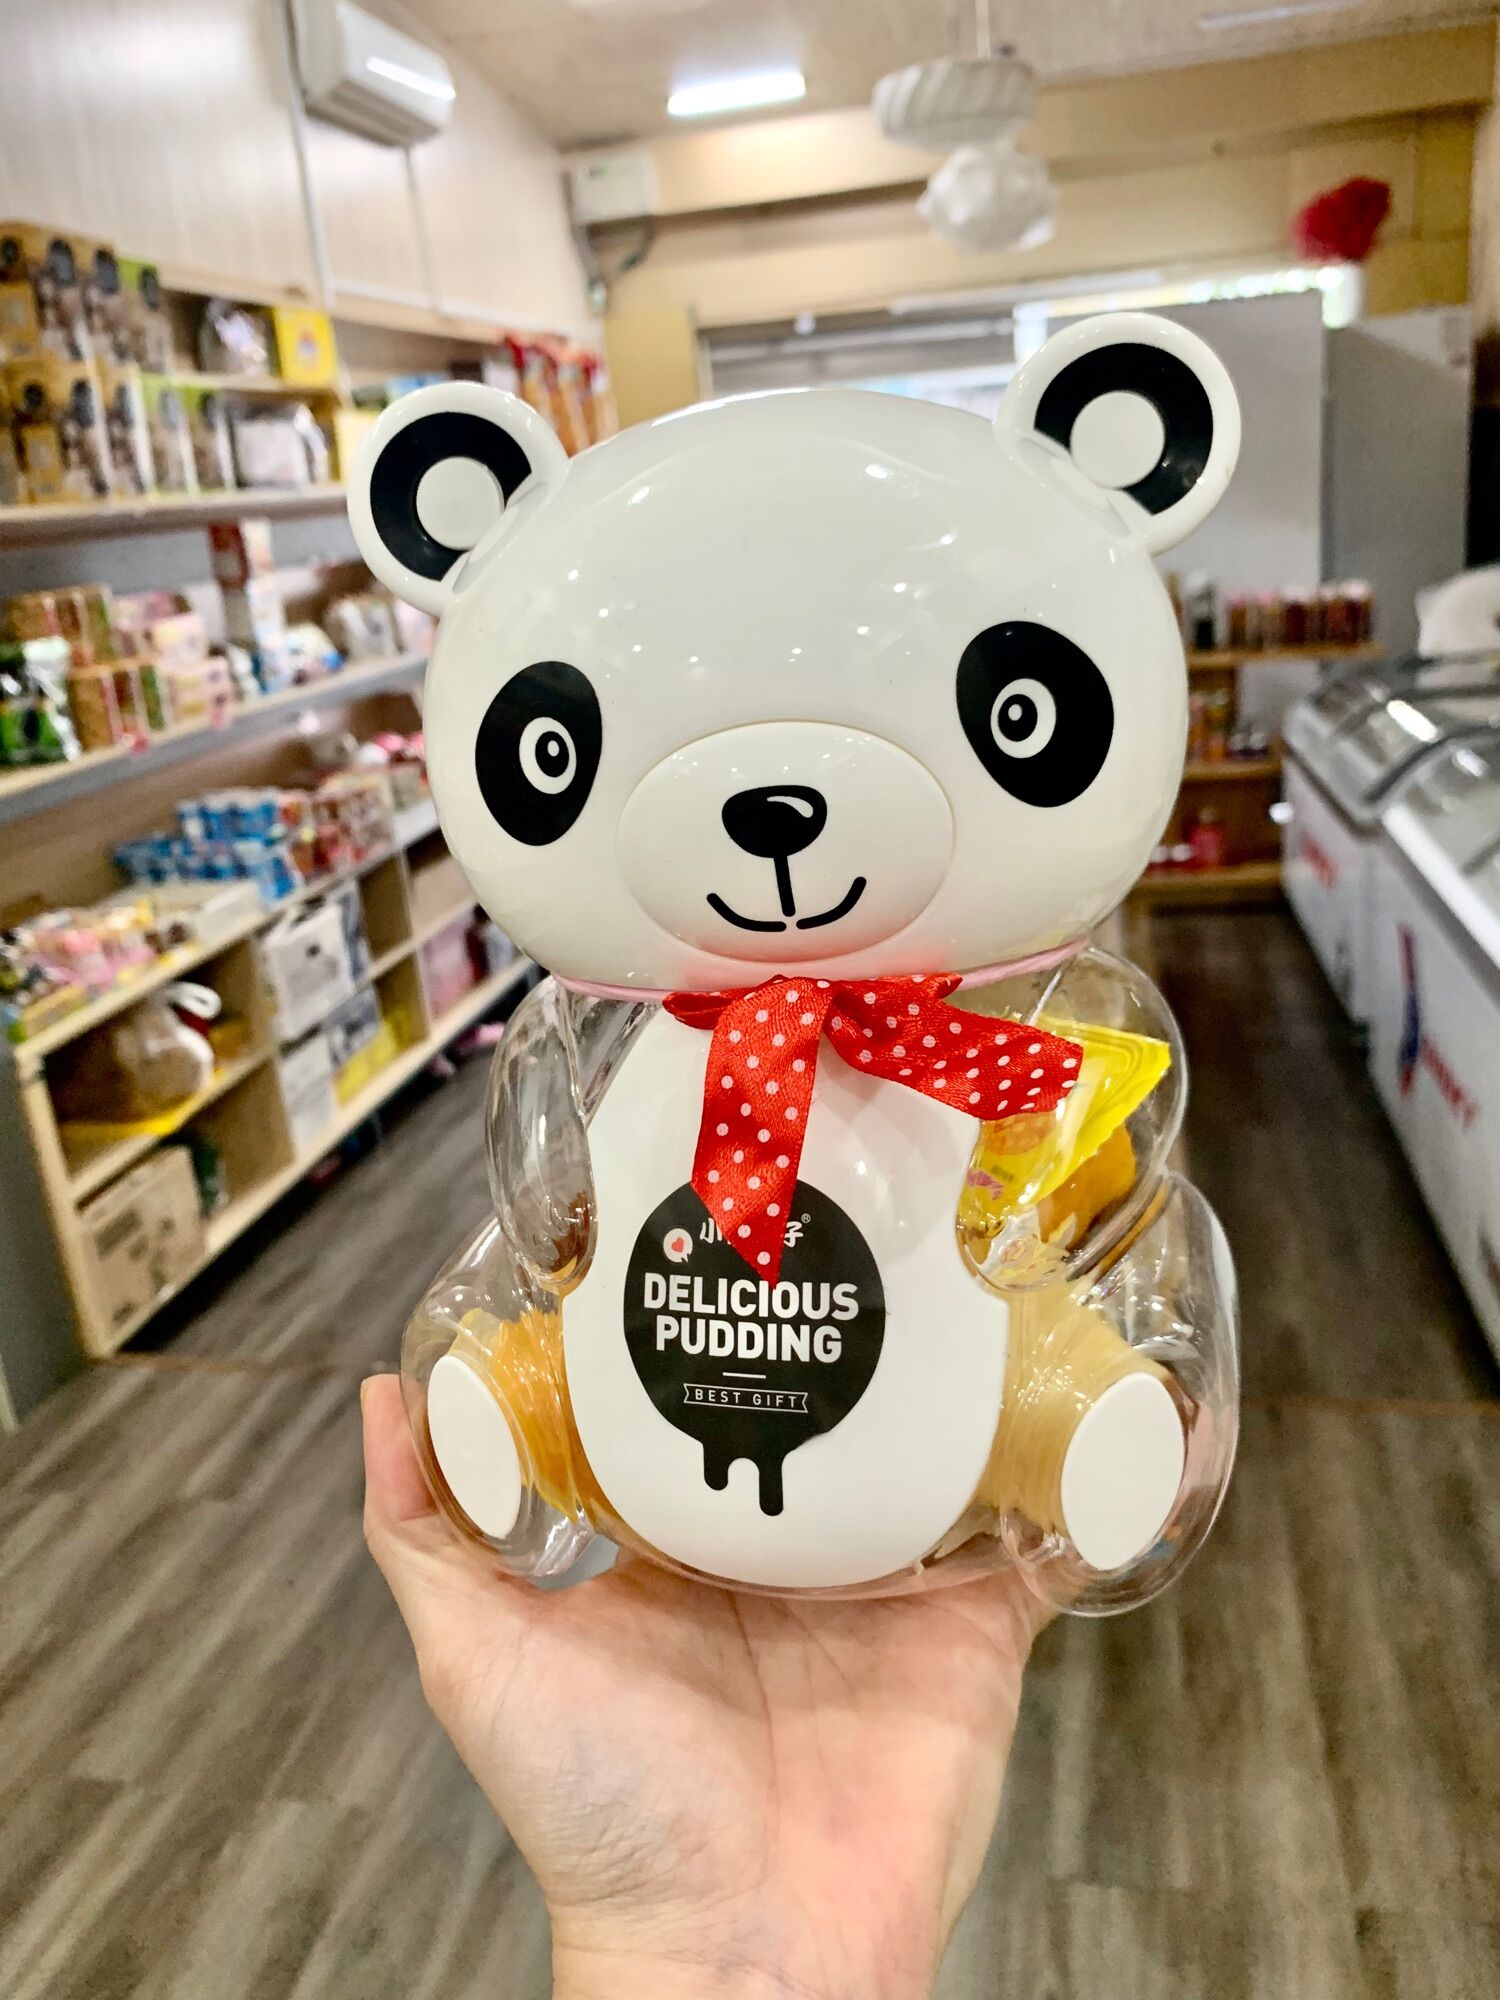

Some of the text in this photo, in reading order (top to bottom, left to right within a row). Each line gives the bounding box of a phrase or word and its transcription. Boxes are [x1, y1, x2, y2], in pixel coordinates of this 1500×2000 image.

[644, 1273, 858, 1320] DELICIOUS
[657, 1315, 841, 1363] PUDDING
[695, 1389, 796, 1407] BEST GIFT
